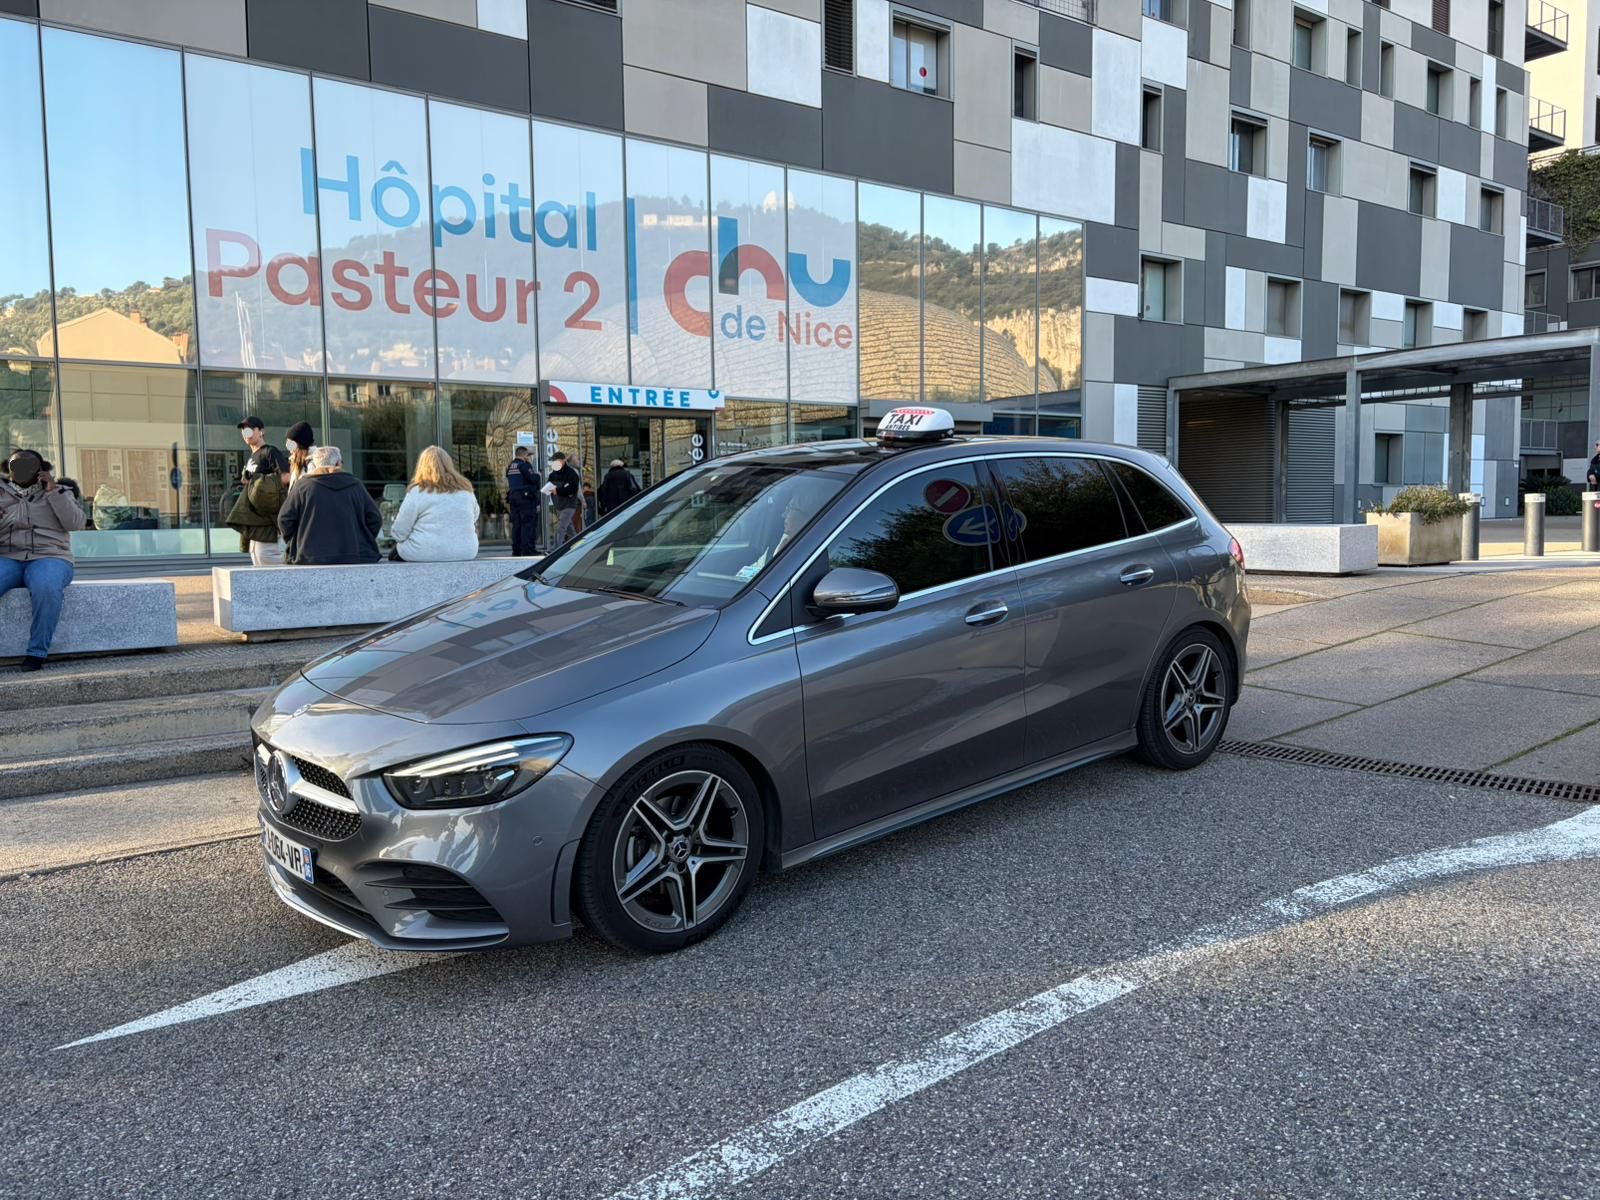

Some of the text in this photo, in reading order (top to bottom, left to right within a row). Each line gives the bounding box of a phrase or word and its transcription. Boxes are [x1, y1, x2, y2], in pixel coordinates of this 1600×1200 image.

[300, 147, 597, 251] Hôpital
[205, 228, 603, 331] Pasteur 2
[720, 305, 853, 349] de Nice
[590, 386, 690, 408] ENTRÉE
[888, 414, 923, 426] TAXI
